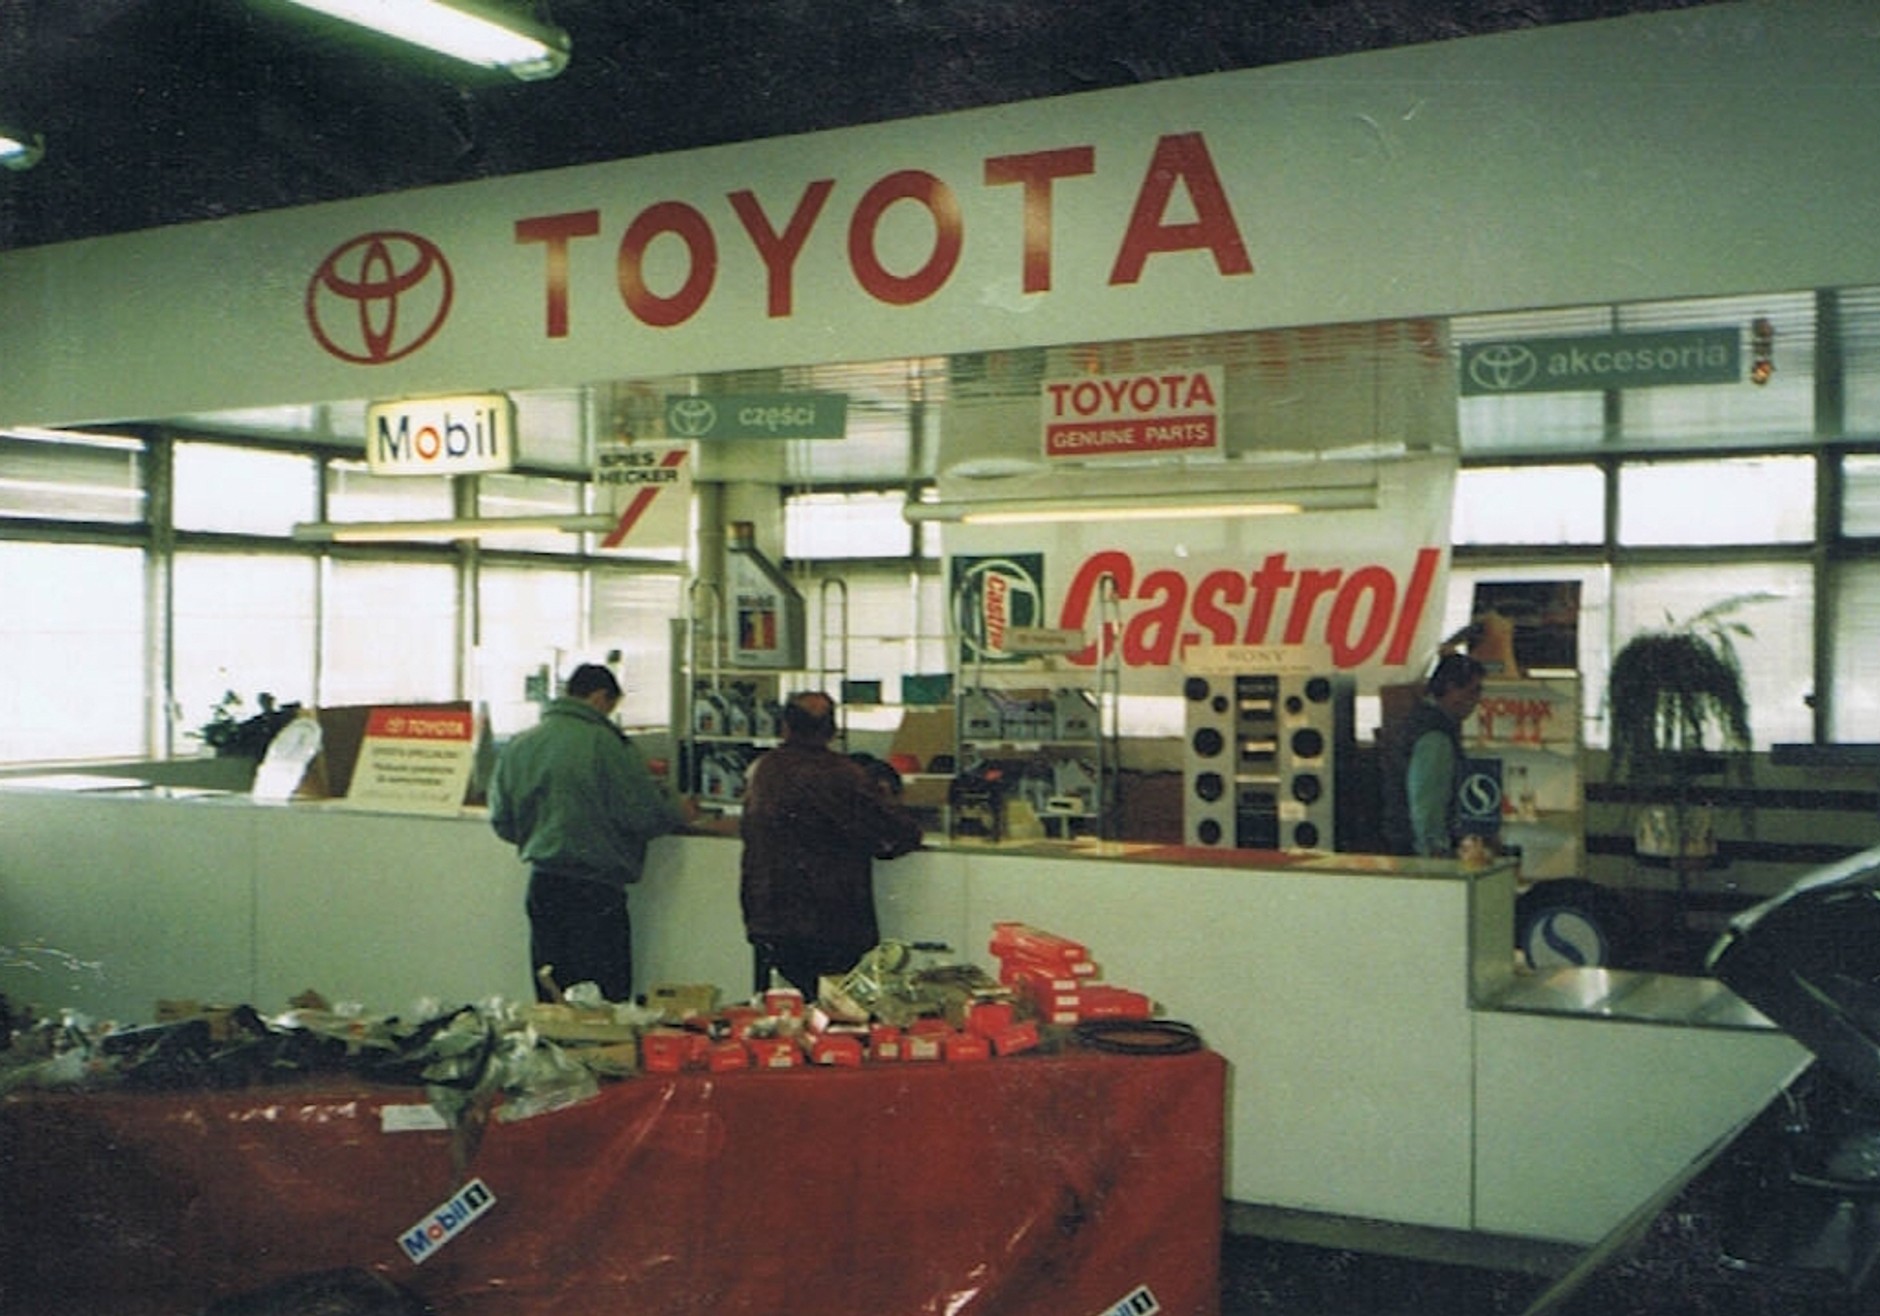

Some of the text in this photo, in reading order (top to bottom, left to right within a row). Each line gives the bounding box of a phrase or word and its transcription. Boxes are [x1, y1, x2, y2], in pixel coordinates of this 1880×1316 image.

[514, 131, 1255, 338] TOYOTA
[1547, 341, 1729, 376] akcesoria
[1046, 372, 1216, 417] TOYOTA
[377, 408, 498, 463] Mobil
[738, 403, 817, 433] części
[1053, 422, 1208, 449] GENUINE PARTS
[599, 468, 679, 486] HECKER
[600, 452, 656, 467] SPIES
[1058, 547, 1441, 669] Castrol
[403, 1199, 469, 1257] Mobil
